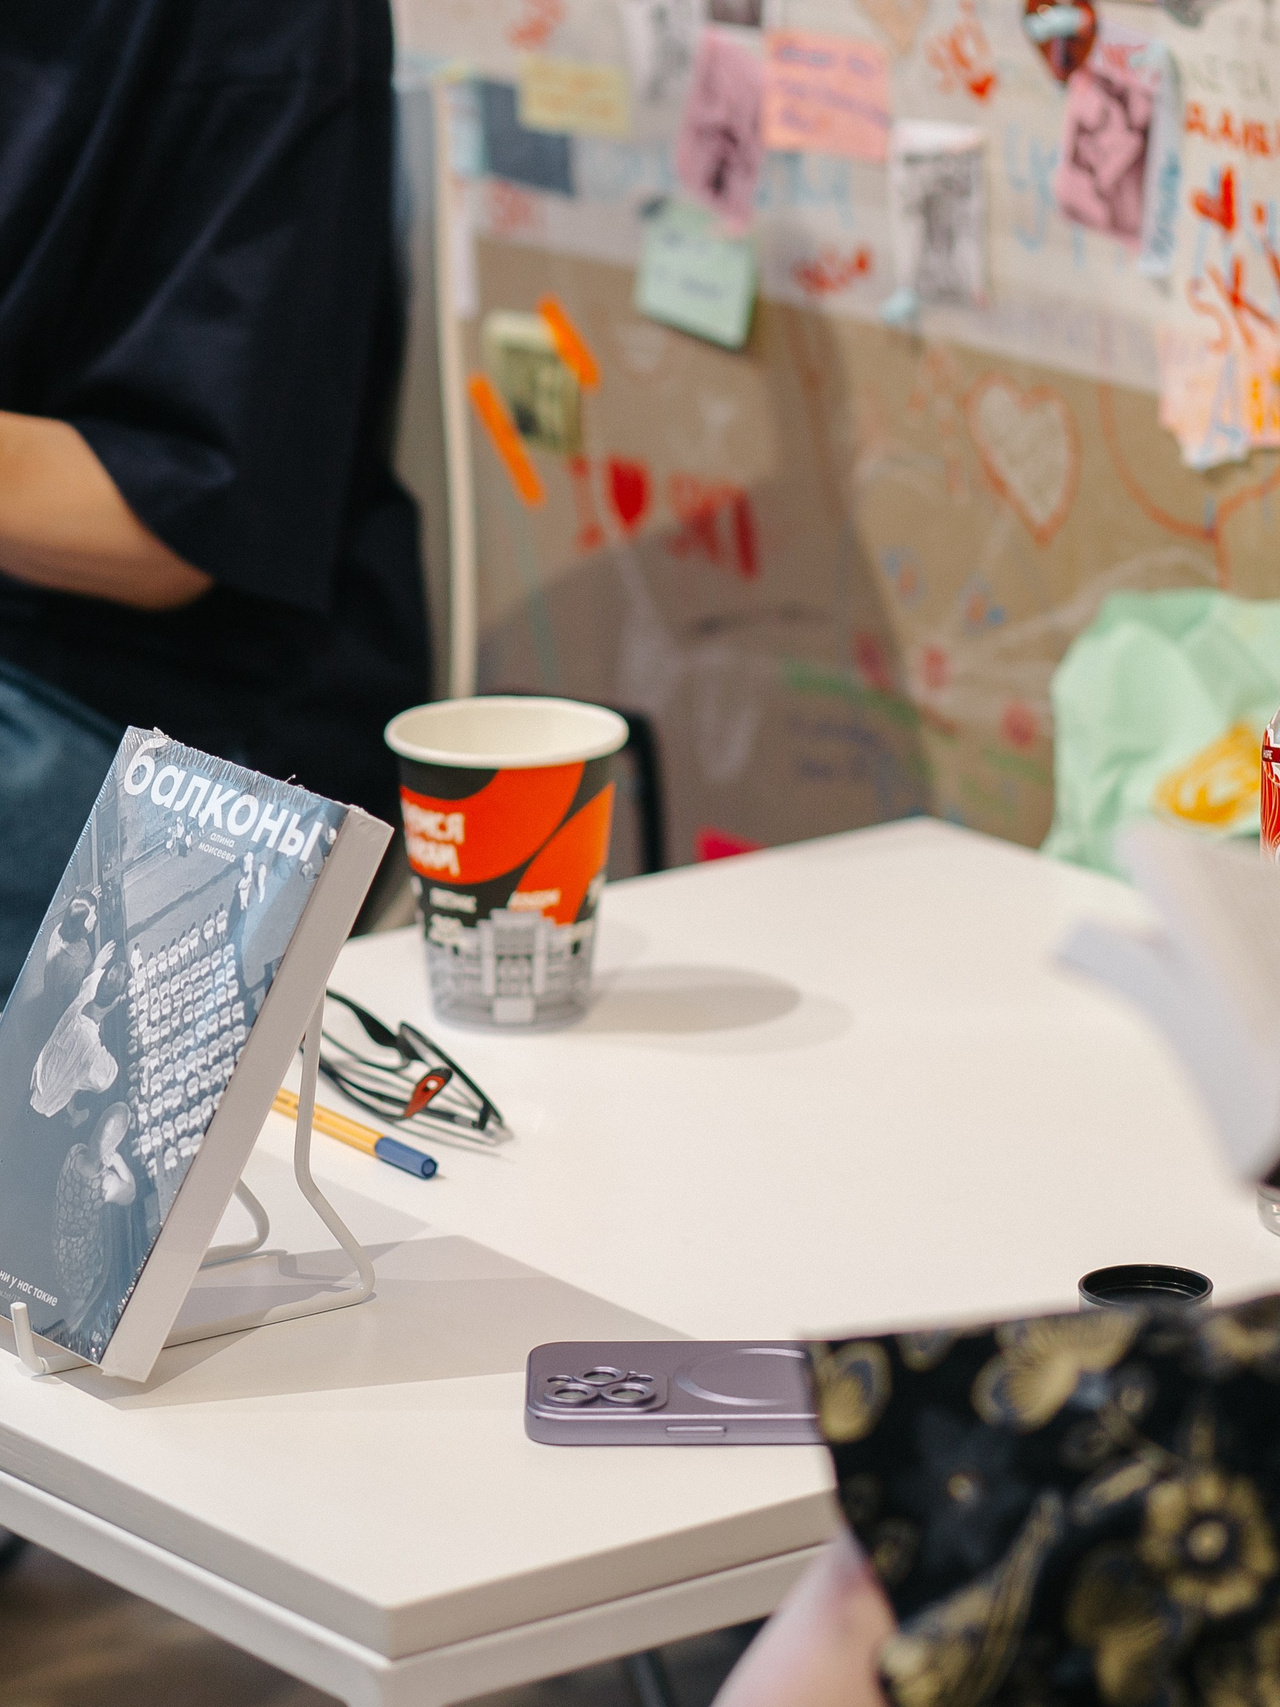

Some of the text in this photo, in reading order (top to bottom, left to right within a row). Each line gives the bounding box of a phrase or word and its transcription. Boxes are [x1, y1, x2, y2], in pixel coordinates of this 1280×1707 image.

[123, 738, 323, 862] балконы
[198, 842, 236, 863] моисеева
[210, 832, 235, 848] алина
[8, 1276, 18, 1289] у
[16, 1279, 34, 1295] нас
[32, 1286, 58, 1307] такие
